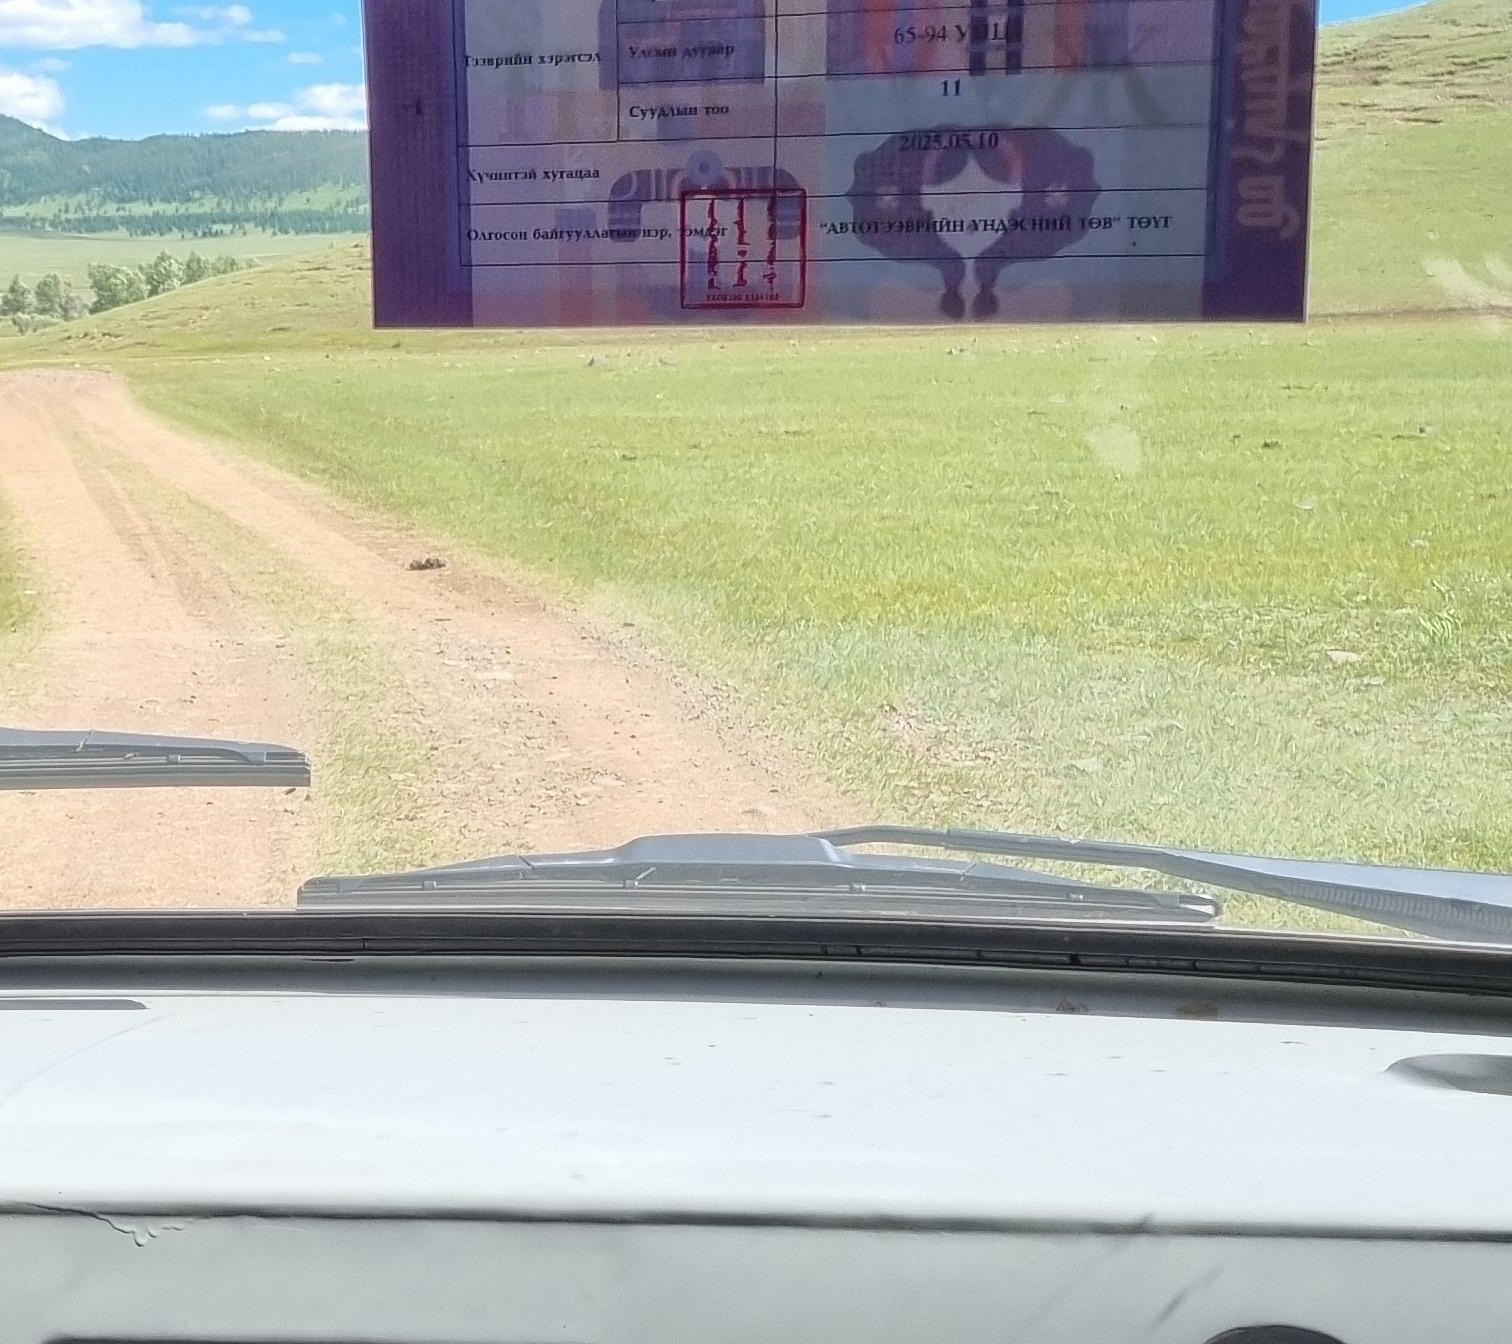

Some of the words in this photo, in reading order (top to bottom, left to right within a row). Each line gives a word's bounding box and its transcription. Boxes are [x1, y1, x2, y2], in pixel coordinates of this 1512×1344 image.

[893, 23, 949, 45] 65-94
[940, 78, 962, 97] 11
[629, 105, 698, 119] Суудлын
[704, 104, 730, 116] тоо
[467, 228, 529, 242] Олгосон
